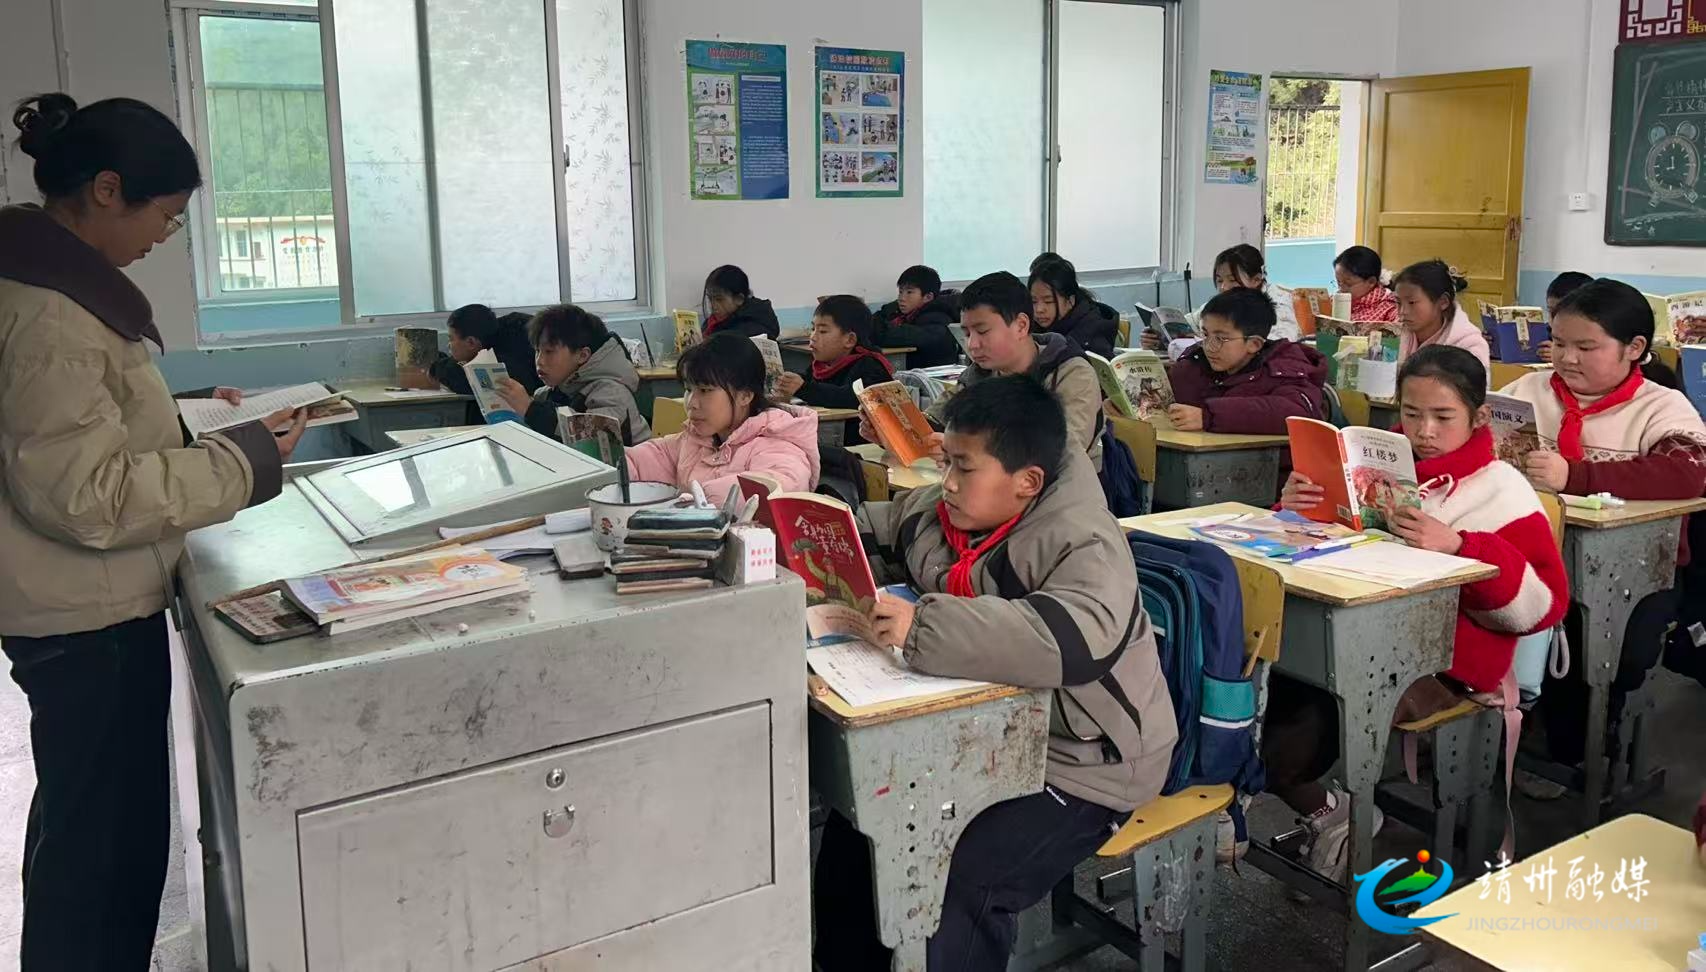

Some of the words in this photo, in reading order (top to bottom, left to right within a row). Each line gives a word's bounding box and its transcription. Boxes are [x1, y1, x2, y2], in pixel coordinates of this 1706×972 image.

[1129, 365, 1152, 375] 水浒传
[1491, 409, 1524, 424] 国演义
[1362, 446, 1399, 463] 红楼梦
